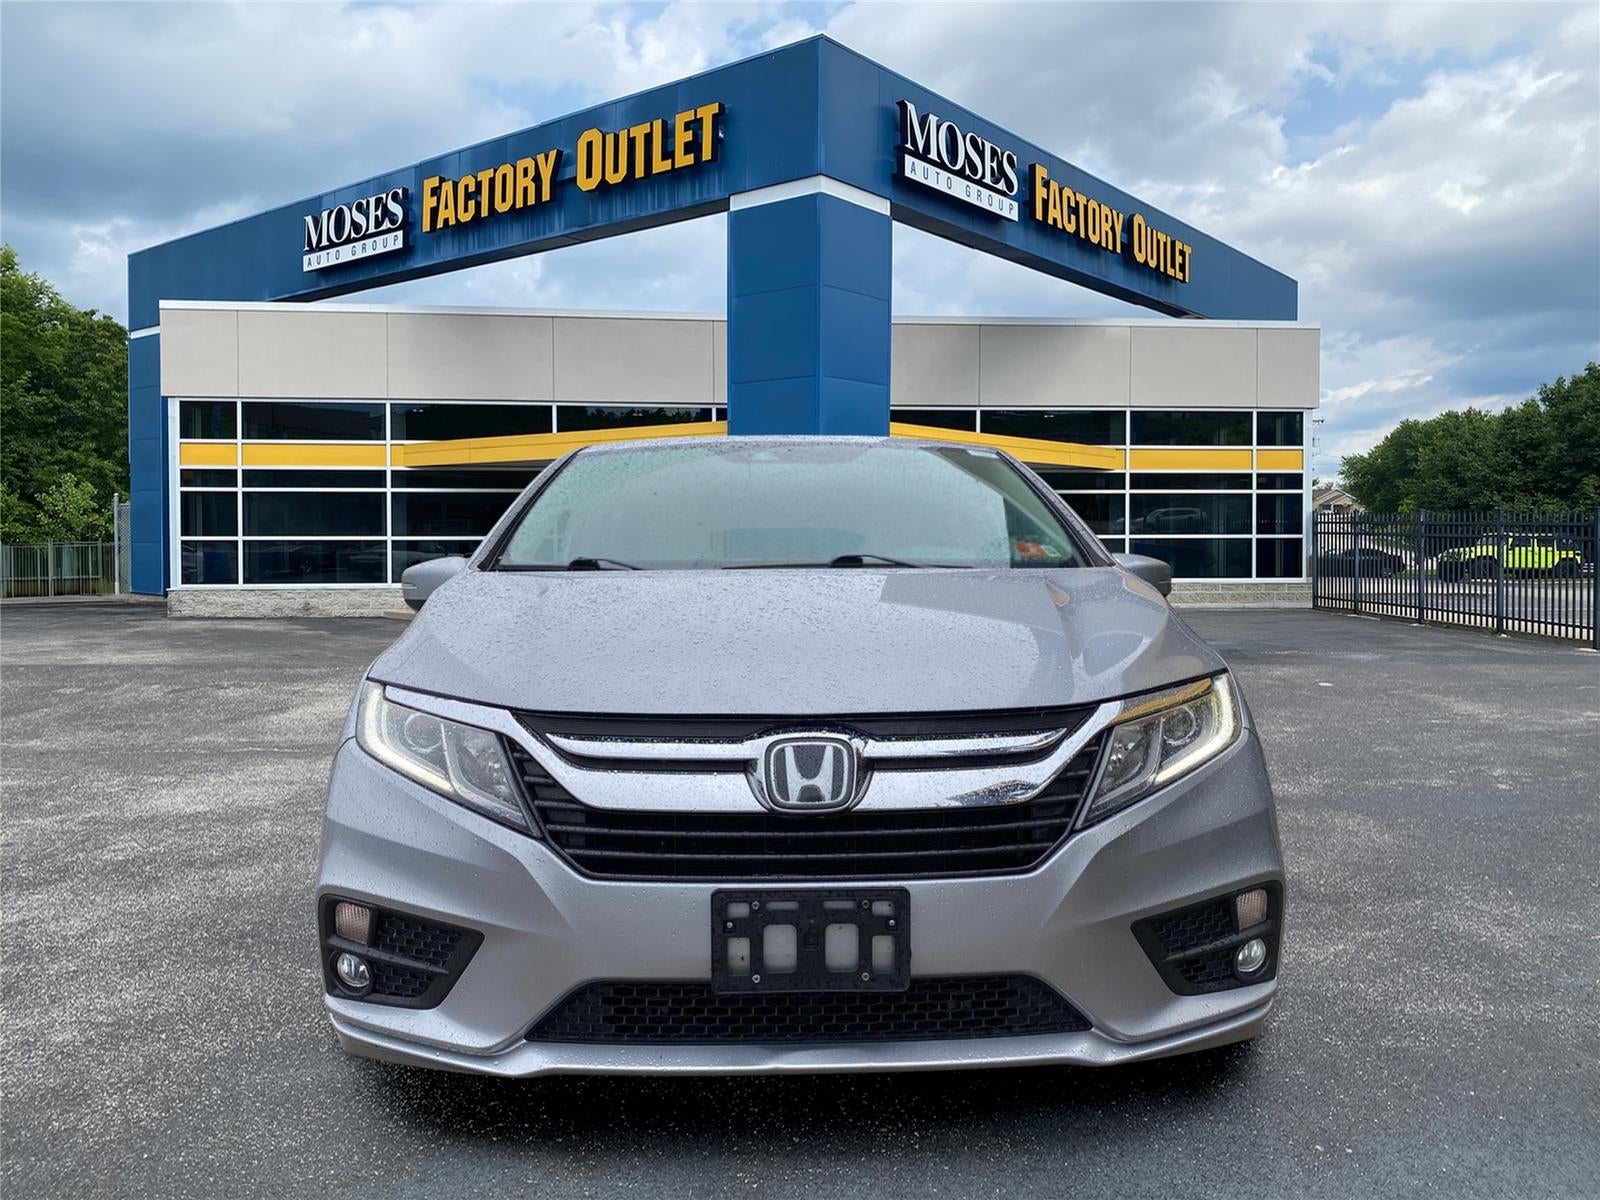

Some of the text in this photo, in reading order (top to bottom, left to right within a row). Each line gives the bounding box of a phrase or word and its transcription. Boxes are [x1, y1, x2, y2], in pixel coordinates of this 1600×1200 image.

[422, 102, 720, 233] FACTORY OUTLET
[903, 99, 1018, 196] MOSES
[303, 187, 404, 251] MOSES
[910, 161, 1014, 215] AUTO GROUP
[1035, 163, 1192, 283] FACTORY OUTLET
[307, 234, 399, 267] AUTO GROUP
